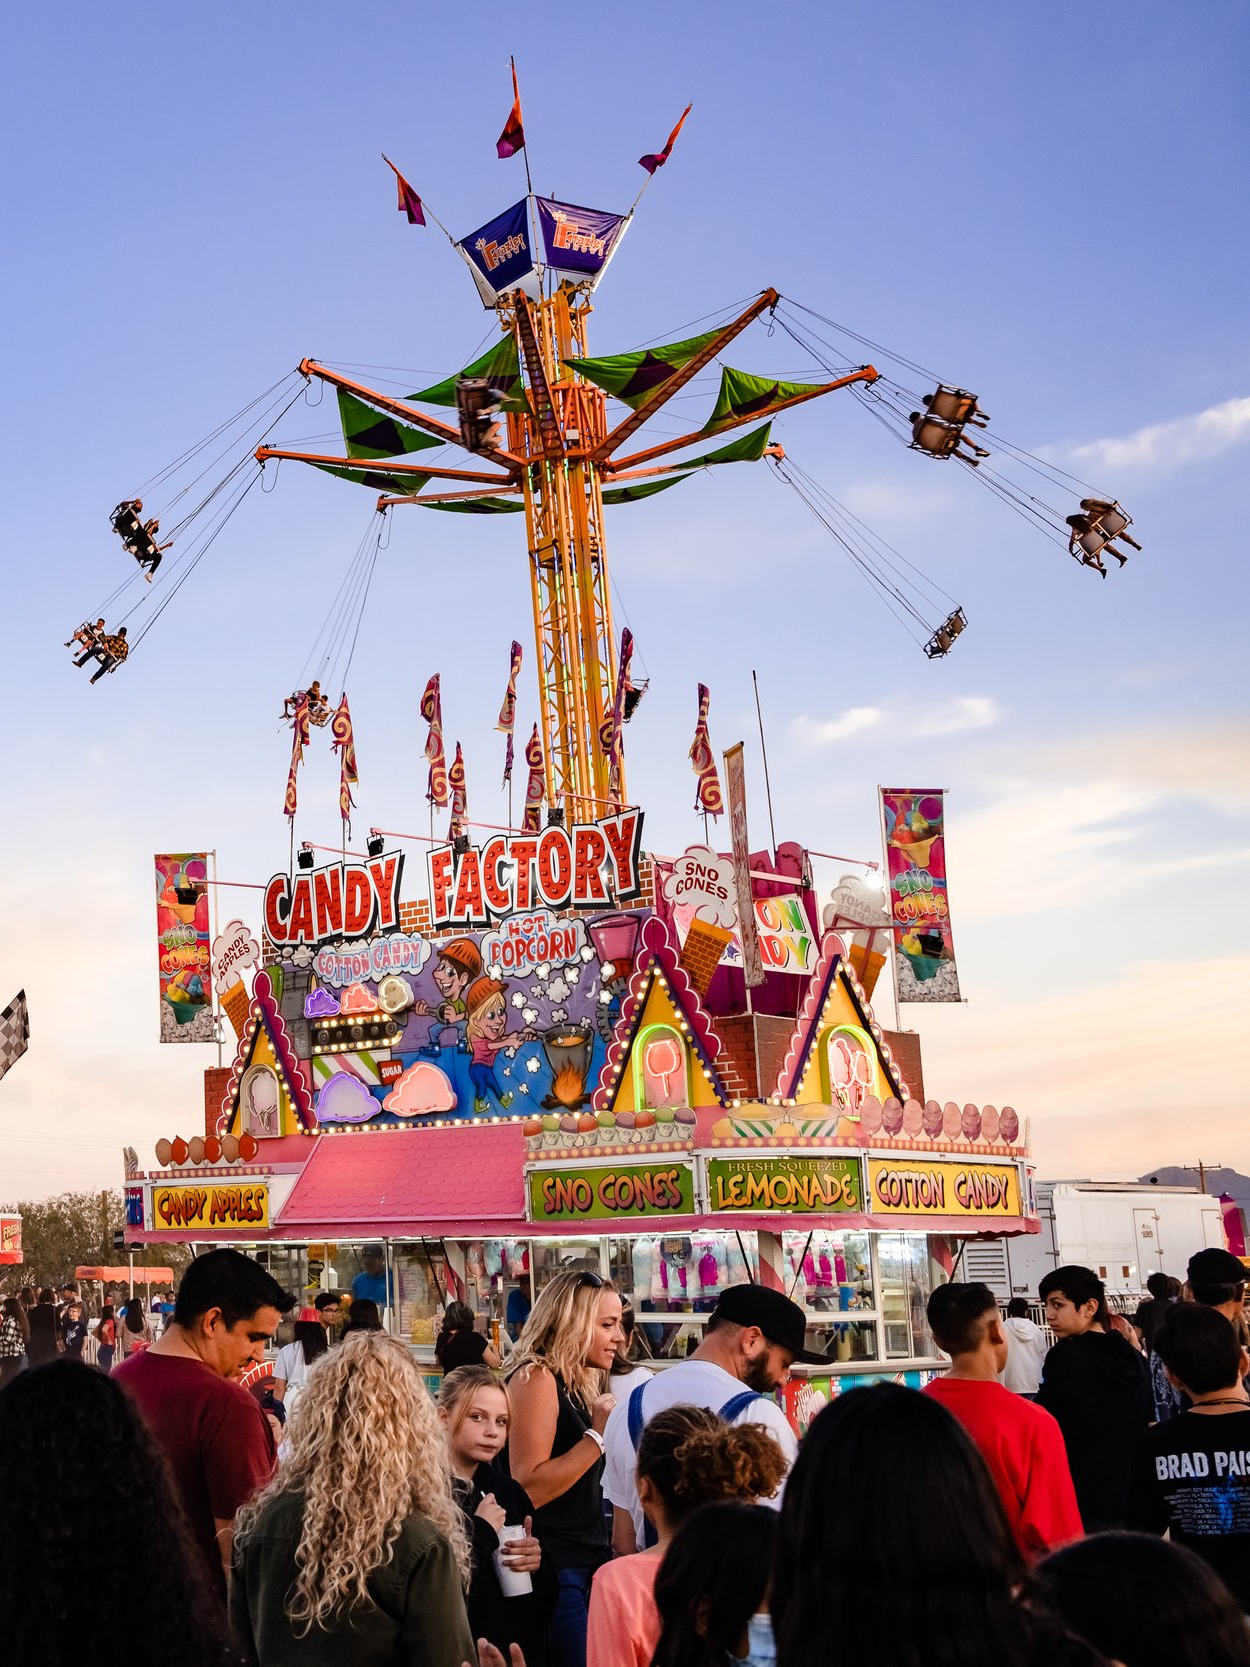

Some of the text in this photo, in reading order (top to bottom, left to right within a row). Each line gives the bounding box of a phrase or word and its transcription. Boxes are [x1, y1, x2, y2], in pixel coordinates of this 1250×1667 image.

[264, 809, 642, 943] CANDY FACTORY
[685, 862, 719, 881] SNO
[895, 868, 933, 897] SNO
[676, 877, 728, 900] CONES
[894, 893, 947, 923] CONES
[163, 924, 197, 946] SNO
[508, 915, 548, 938] HOT
[161, 945, 209, 974] CONES
[217, 935, 245, 970] CANDY
[219, 943, 250, 980] APPLES
[317, 939, 421, 979] COTTON CANDY
[491, 925, 577, 968] POPCORN
[381, 1066, 402, 1079] SUGAR
[728, 1161, 847, 1173] FRESH SQUEEZED
[542, 1168, 682, 1214] SNO CONES
[717, 1172, 857, 1208] LEMONADE
[875, 1168, 945, 1208] COTTON
[954, 1170, 1008, 1210] CANDY
[158, 1189, 207, 1226] CANDY
[209, 1188, 264, 1225] APPLES
[1155, 1452, 1209, 1480] BRAD
